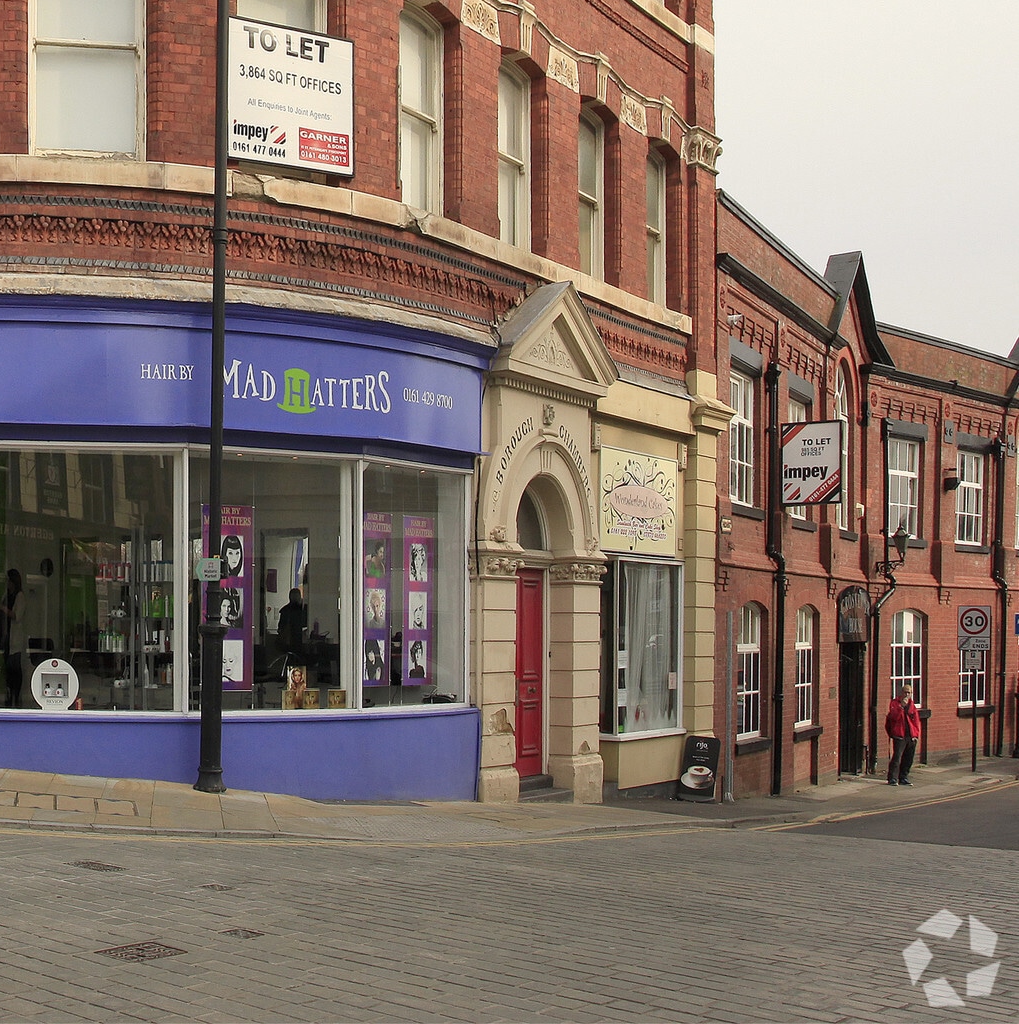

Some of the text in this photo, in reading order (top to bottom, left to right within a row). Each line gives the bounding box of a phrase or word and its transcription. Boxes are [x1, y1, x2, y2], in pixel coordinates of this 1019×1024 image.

[243, 25, 329, 63] TO LET
[239, 64, 342, 95] 3,864 SQ FT OFFICES
[247, 97, 333, 121] All Enquiries to Joint Agents:
[233, 119, 268, 142] impey
[300, 130, 346, 144] GARNER
[233, 141, 286, 158] 0161 477 0444
[300, 150, 347, 163] 0161 480 3013
[141, 359, 391, 414] HAIR BY MAD HATTERS
[403, 387, 453, 410] 0161 429 8700
[815, 437, 831, 445] LET
[496, 416, 592, 498] BOROUGH CHAMBERS
[784, 464, 828, 482] impey
[614, 492, 648, 508] Wonderland
[231, 507, 241, 515] BY
[221, 515, 252, 526] HATTERS
[964, 615, 985, 627] 30
